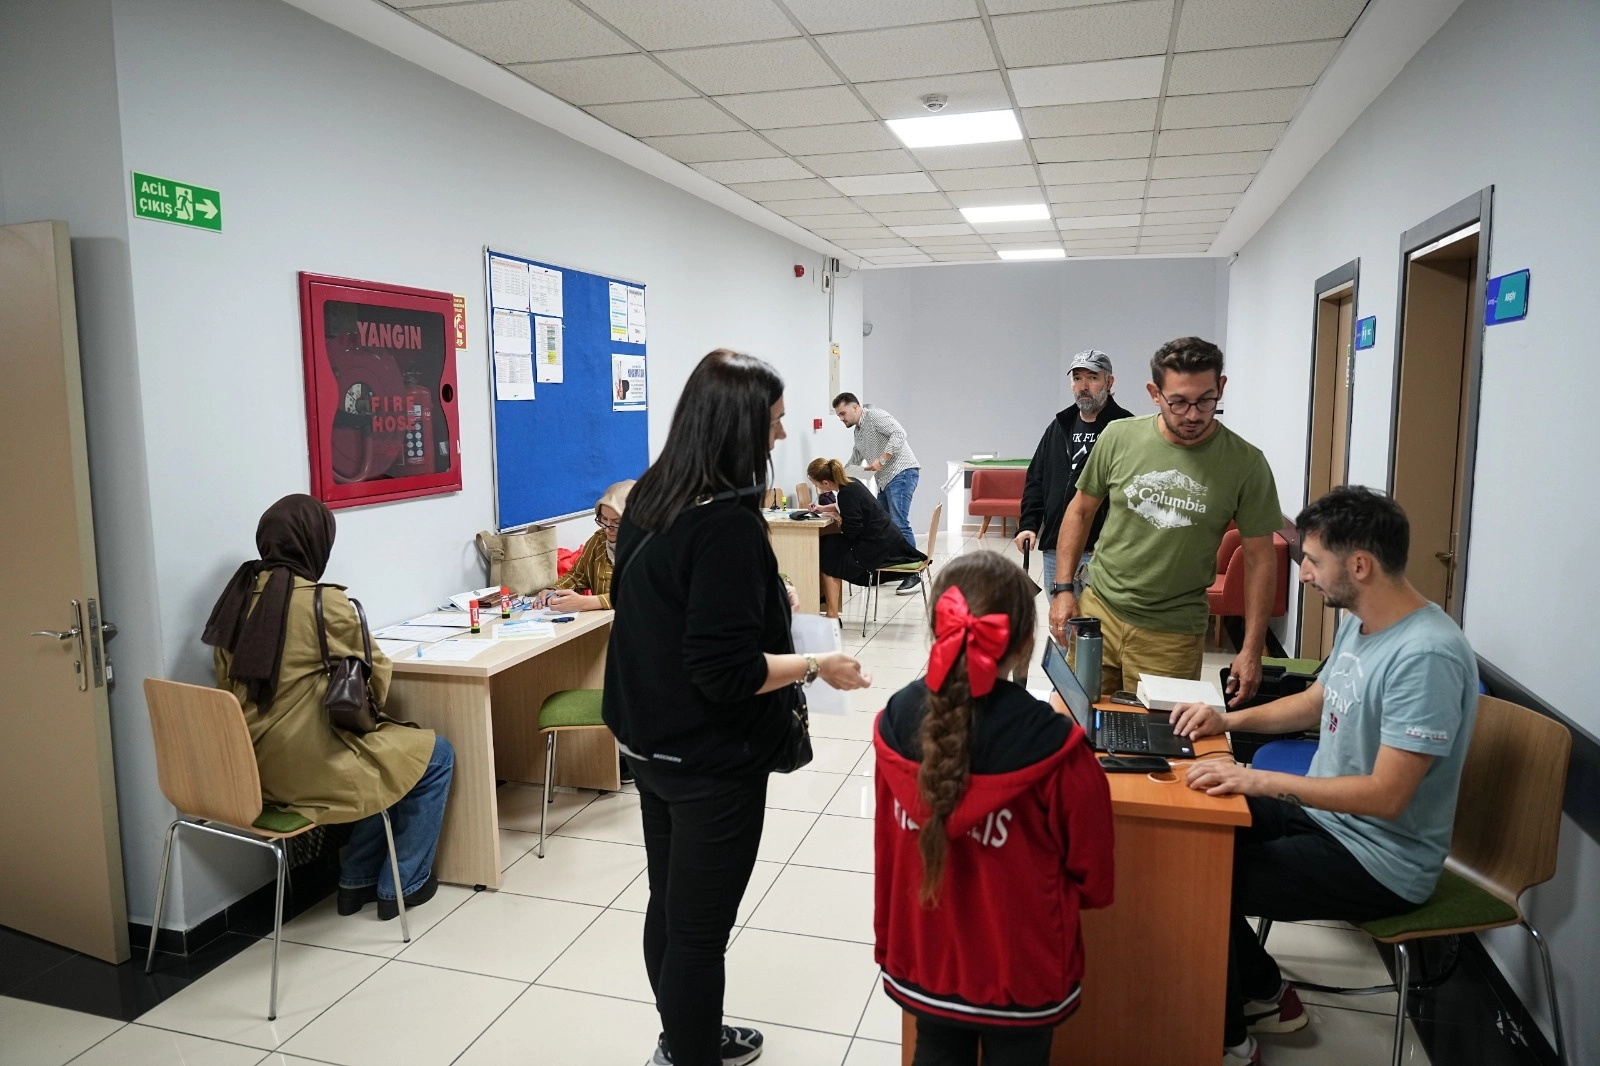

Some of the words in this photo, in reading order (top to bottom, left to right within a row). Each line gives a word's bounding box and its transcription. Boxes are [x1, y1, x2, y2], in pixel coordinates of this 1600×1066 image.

[141, 181, 170, 198] ACİL
[139, 197, 173, 217] ÇIKIŞ
[356, 321, 422, 350] YANGIN
[371, 396, 415, 413] FIRE
[372, 414, 417, 433] HOSE
[1138, 487, 1207, 514] Columbia
